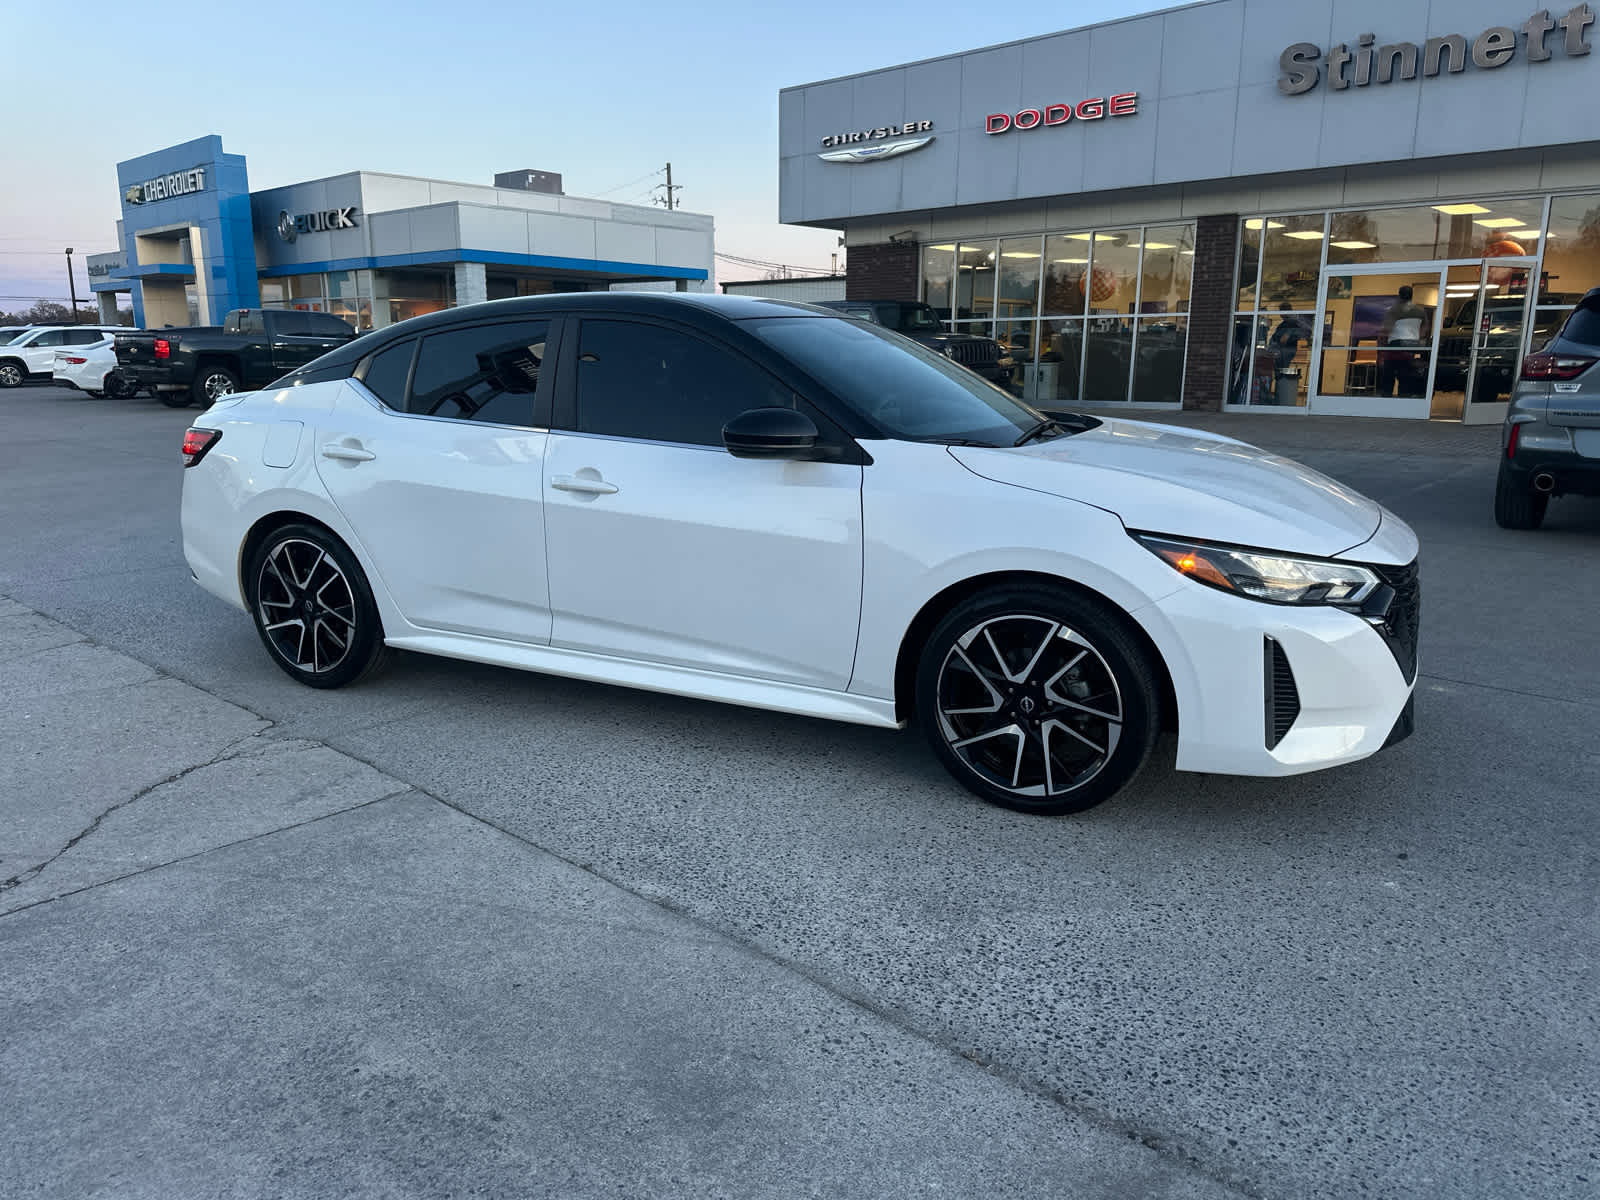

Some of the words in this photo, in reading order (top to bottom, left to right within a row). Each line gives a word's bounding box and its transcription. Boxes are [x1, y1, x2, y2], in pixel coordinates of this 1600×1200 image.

[1277, 2, 1595, 95] Stinnett
[985, 92, 1137, 135] DODGE
[821, 119, 933, 147] CHRYSLER
[143, 168, 205, 202] CHEVROLET
[293, 206, 358, 233] BUICK
